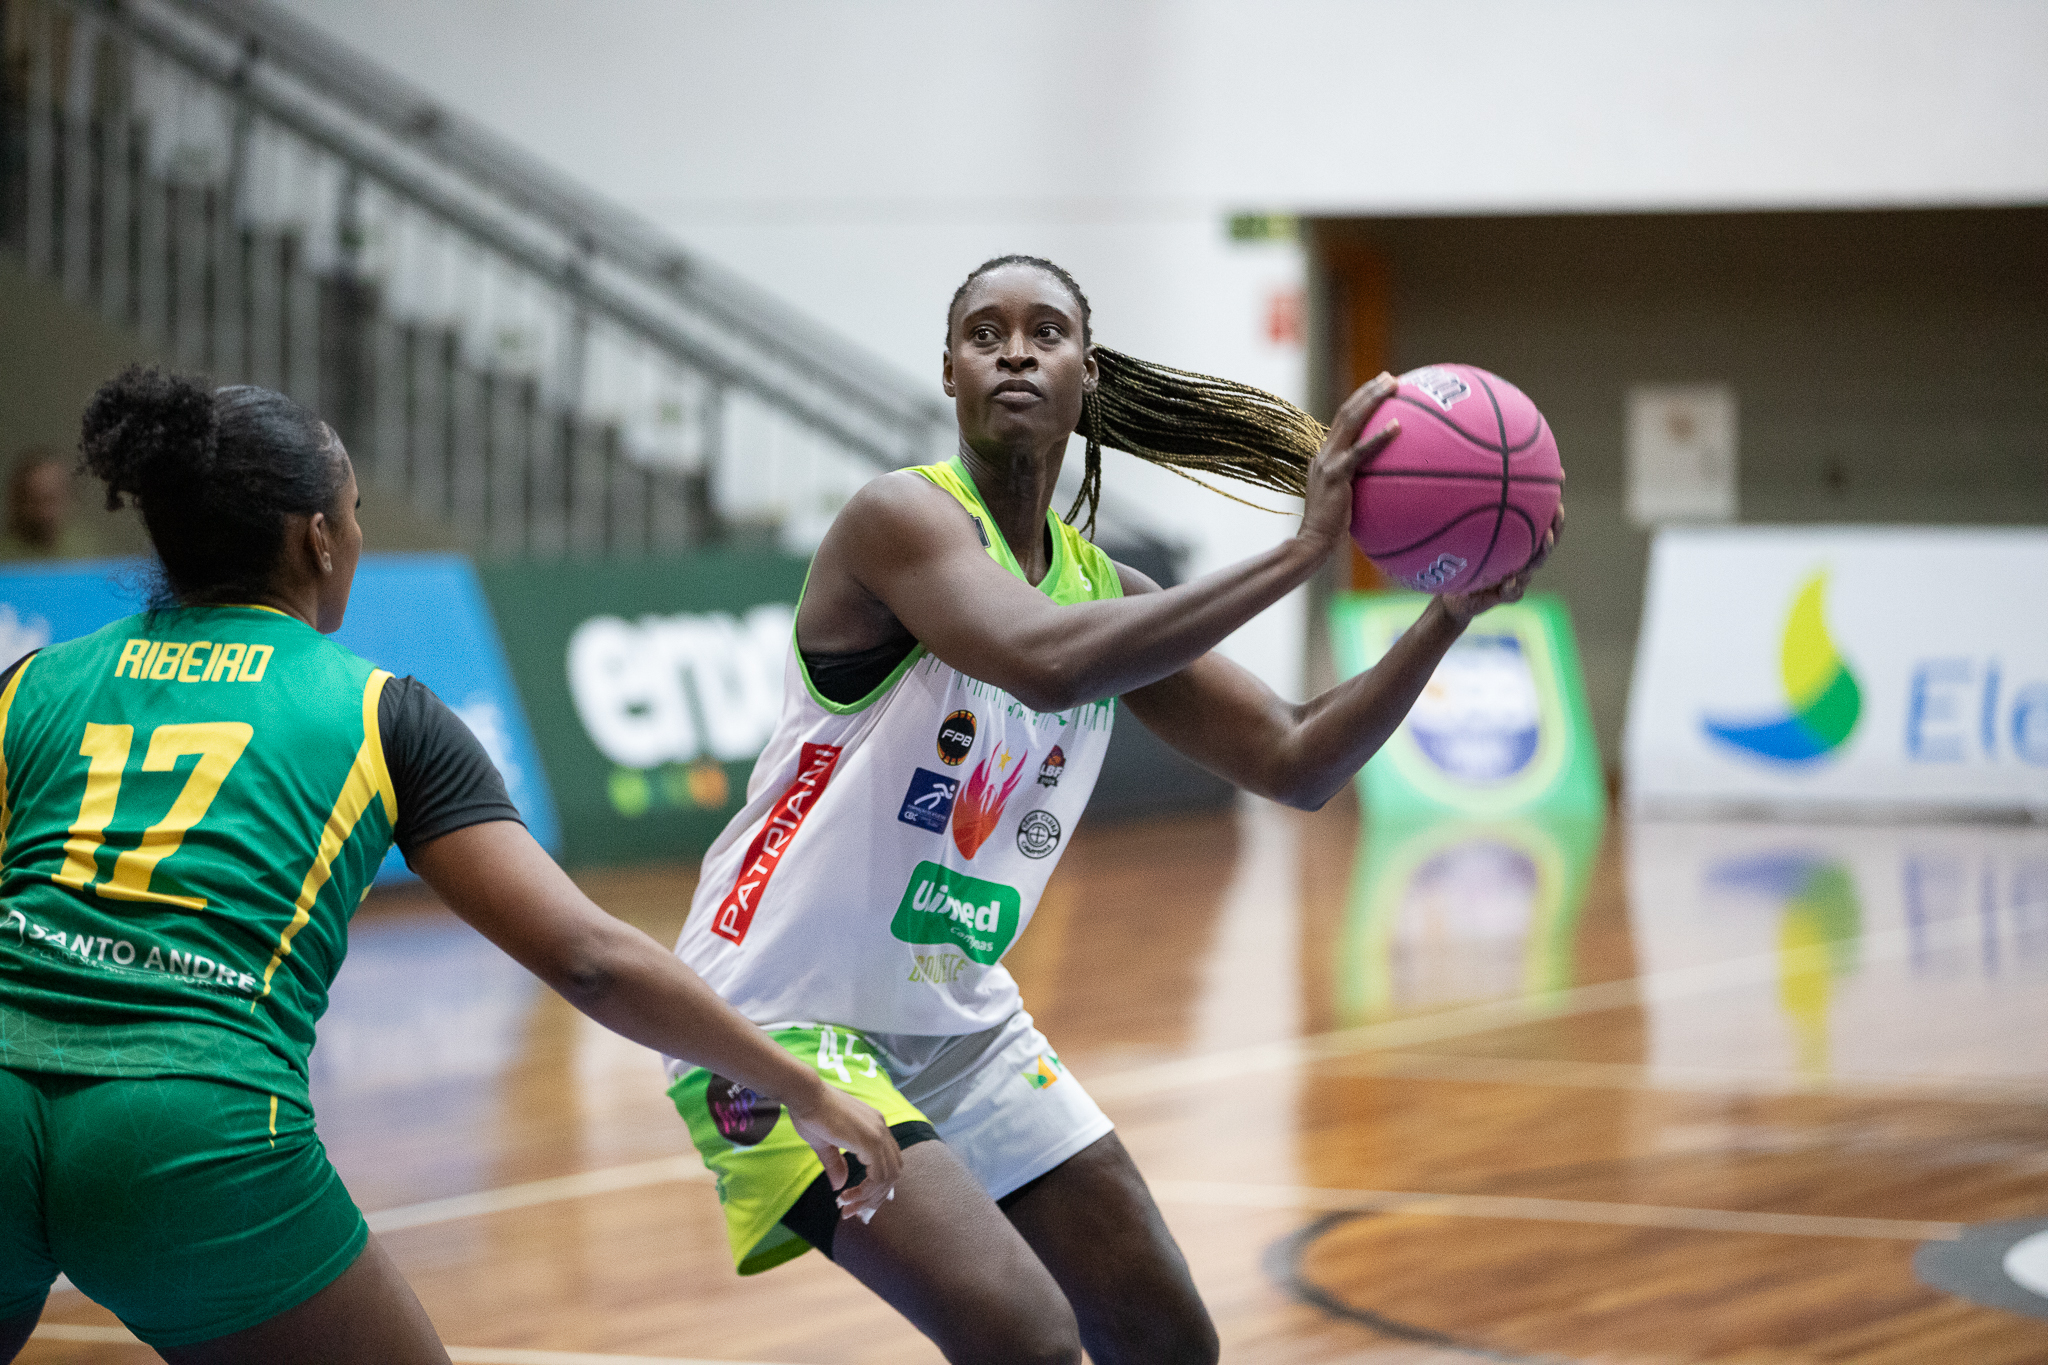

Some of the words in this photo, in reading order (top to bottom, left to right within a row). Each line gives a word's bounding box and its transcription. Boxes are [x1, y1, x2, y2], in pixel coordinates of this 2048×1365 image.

[114, 638, 275, 683] RIBEIRO
[941, 728, 973, 748] FPB
[1040, 763, 1063, 778] LBF
[51, 721, 254, 911] 17
[718, 748, 835, 938] PATRIANI
[28, 923, 136, 966] SANTO
[816, 1025, 878, 1084] 45
